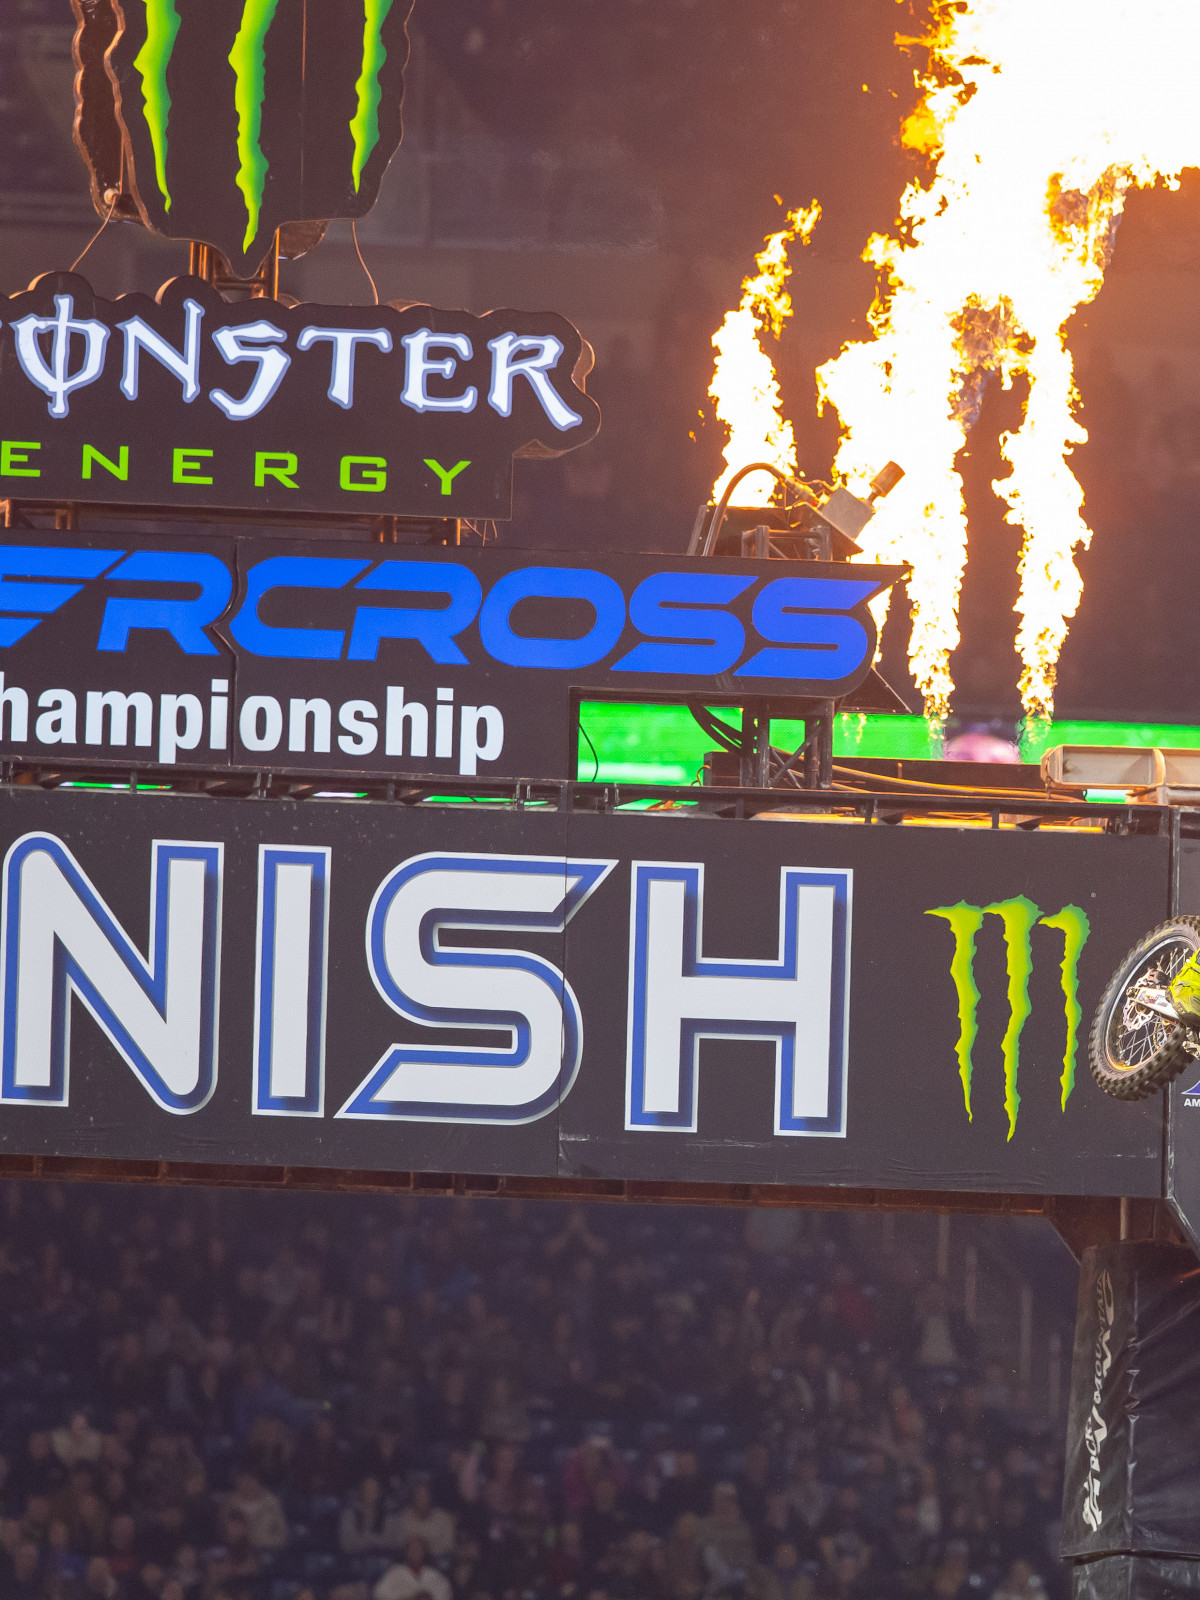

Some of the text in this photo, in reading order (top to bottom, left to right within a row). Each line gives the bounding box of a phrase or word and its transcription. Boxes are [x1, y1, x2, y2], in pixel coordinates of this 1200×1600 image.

[0, 294, 582, 431] ONSTER
[0, 440, 472, 496] ENERGY
[0, 830, 854, 1138] NISH
